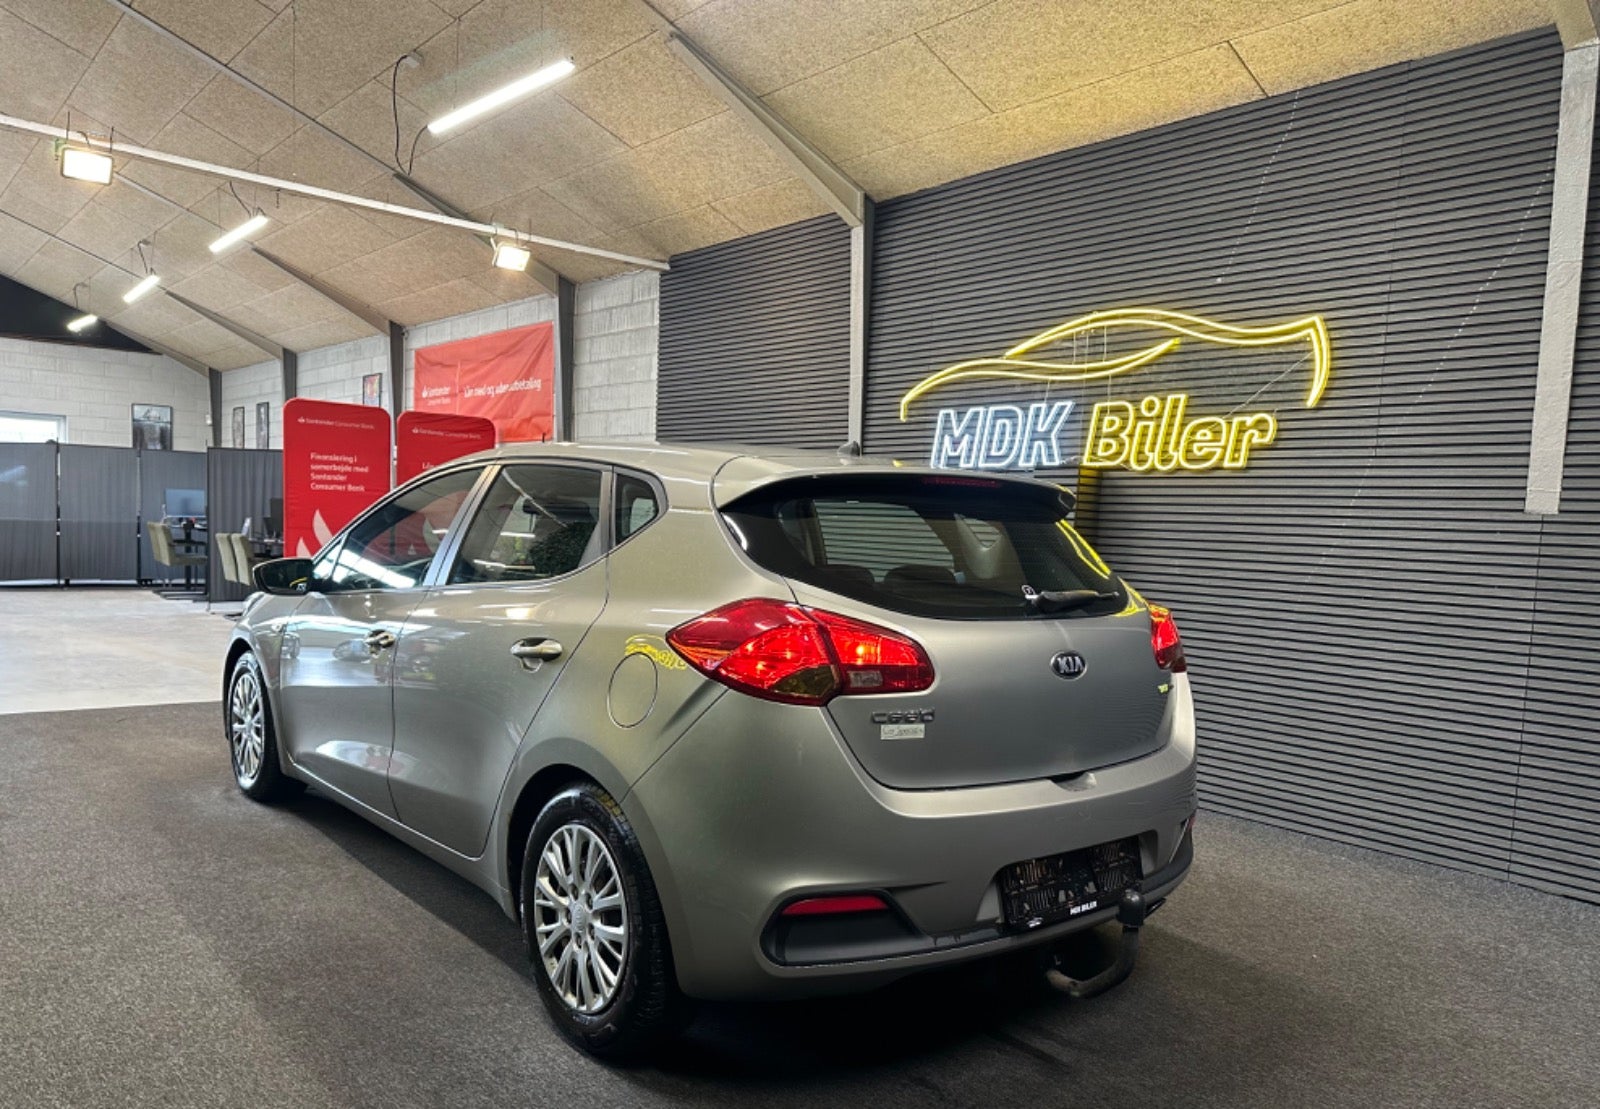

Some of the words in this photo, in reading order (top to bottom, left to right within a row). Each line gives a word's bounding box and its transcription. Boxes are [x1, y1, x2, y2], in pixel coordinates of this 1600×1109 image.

[930, 401, 1076, 469] MDK
[1083, 393, 1278, 472] Biler
[311, 452, 353, 464] Finansiering
[311, 464, 352, 473] samarbejde
[311, 472, 347, 481] Santander
[311, 482, 346, 490] Consumer
[1057, 656, 1084, 673] KIA
